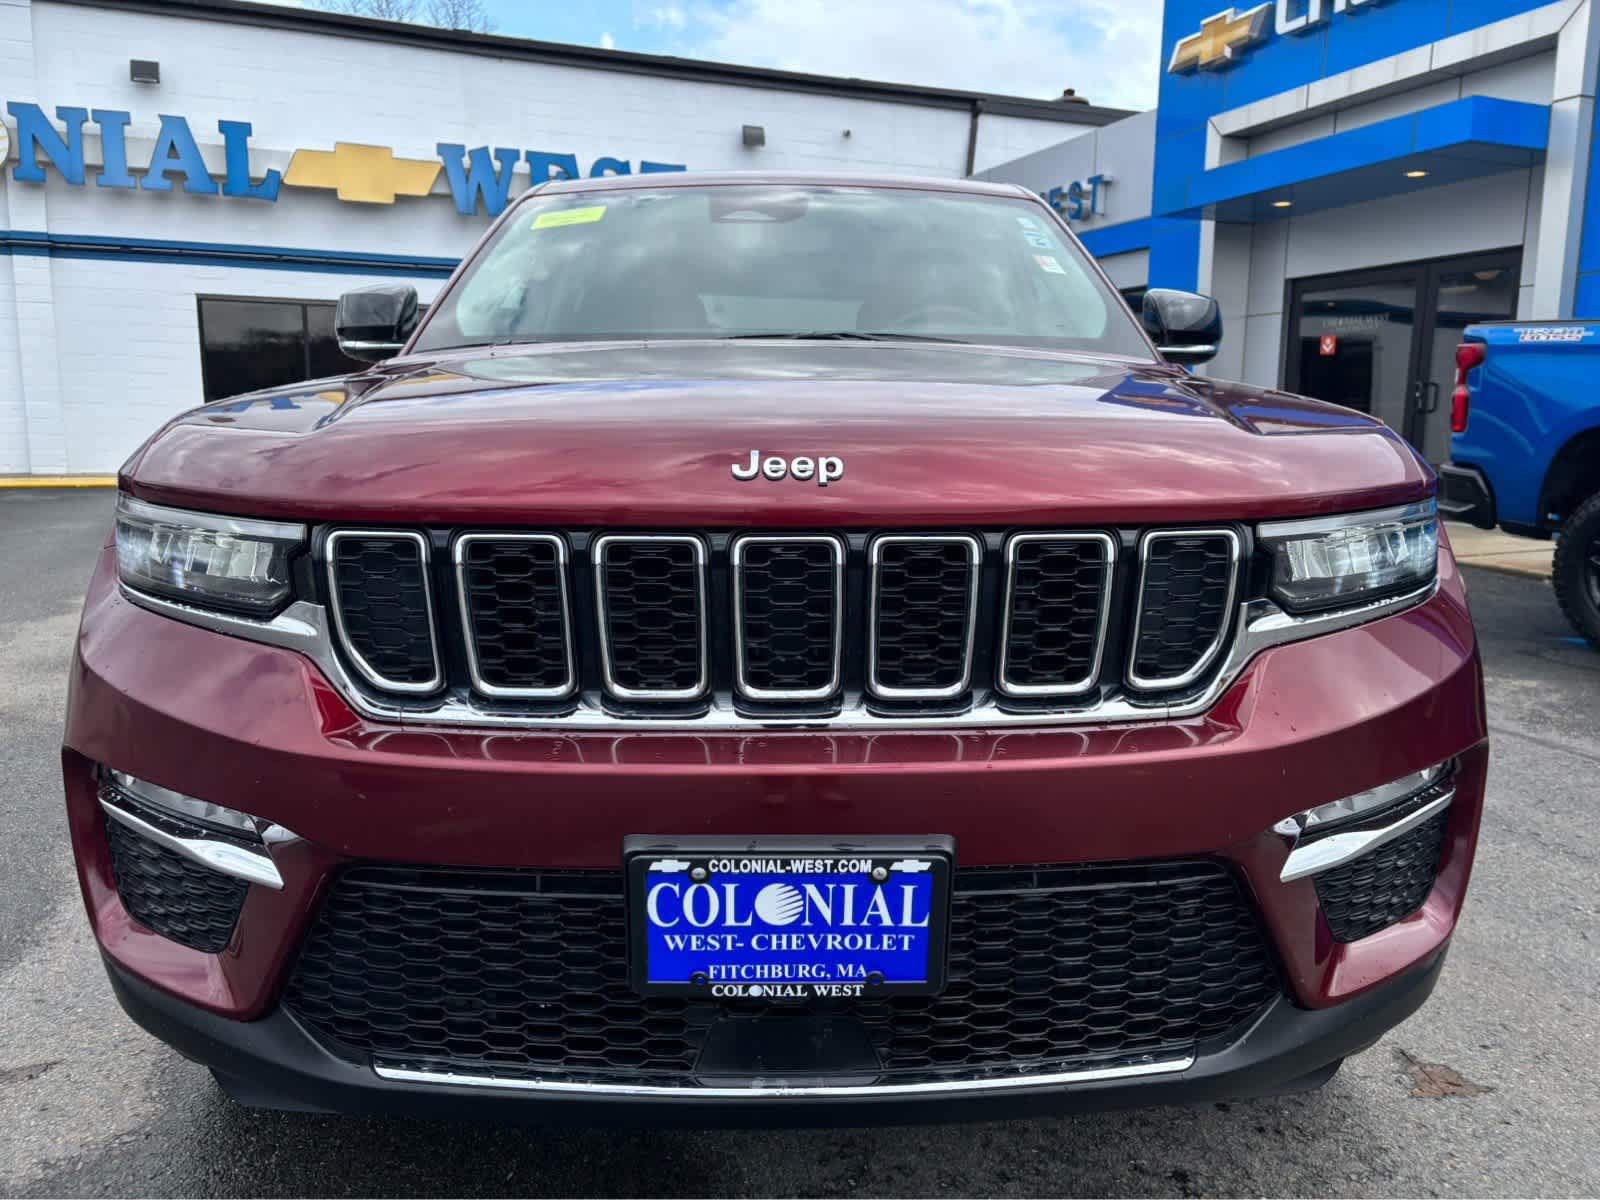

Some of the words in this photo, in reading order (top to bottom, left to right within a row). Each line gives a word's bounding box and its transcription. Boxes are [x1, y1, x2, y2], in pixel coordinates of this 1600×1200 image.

[0, 100, 281, 202] NIAL
[1040, 174, 1105, 221] EST
[731, 449, 844, 487] Jeep
[708, 859, 873, 874] COLONIAL-WEST.COM
[646, 882, 930, 928] COLONIAL
[751, 933, 916, 951] CHEVROLET
[708, 963, 831, 980] FITCHBURG,
[836, 963, 868, 978] MA
[711, 984, 808, 997] COLONIAL
[813, 984, 865, 997] WEST
